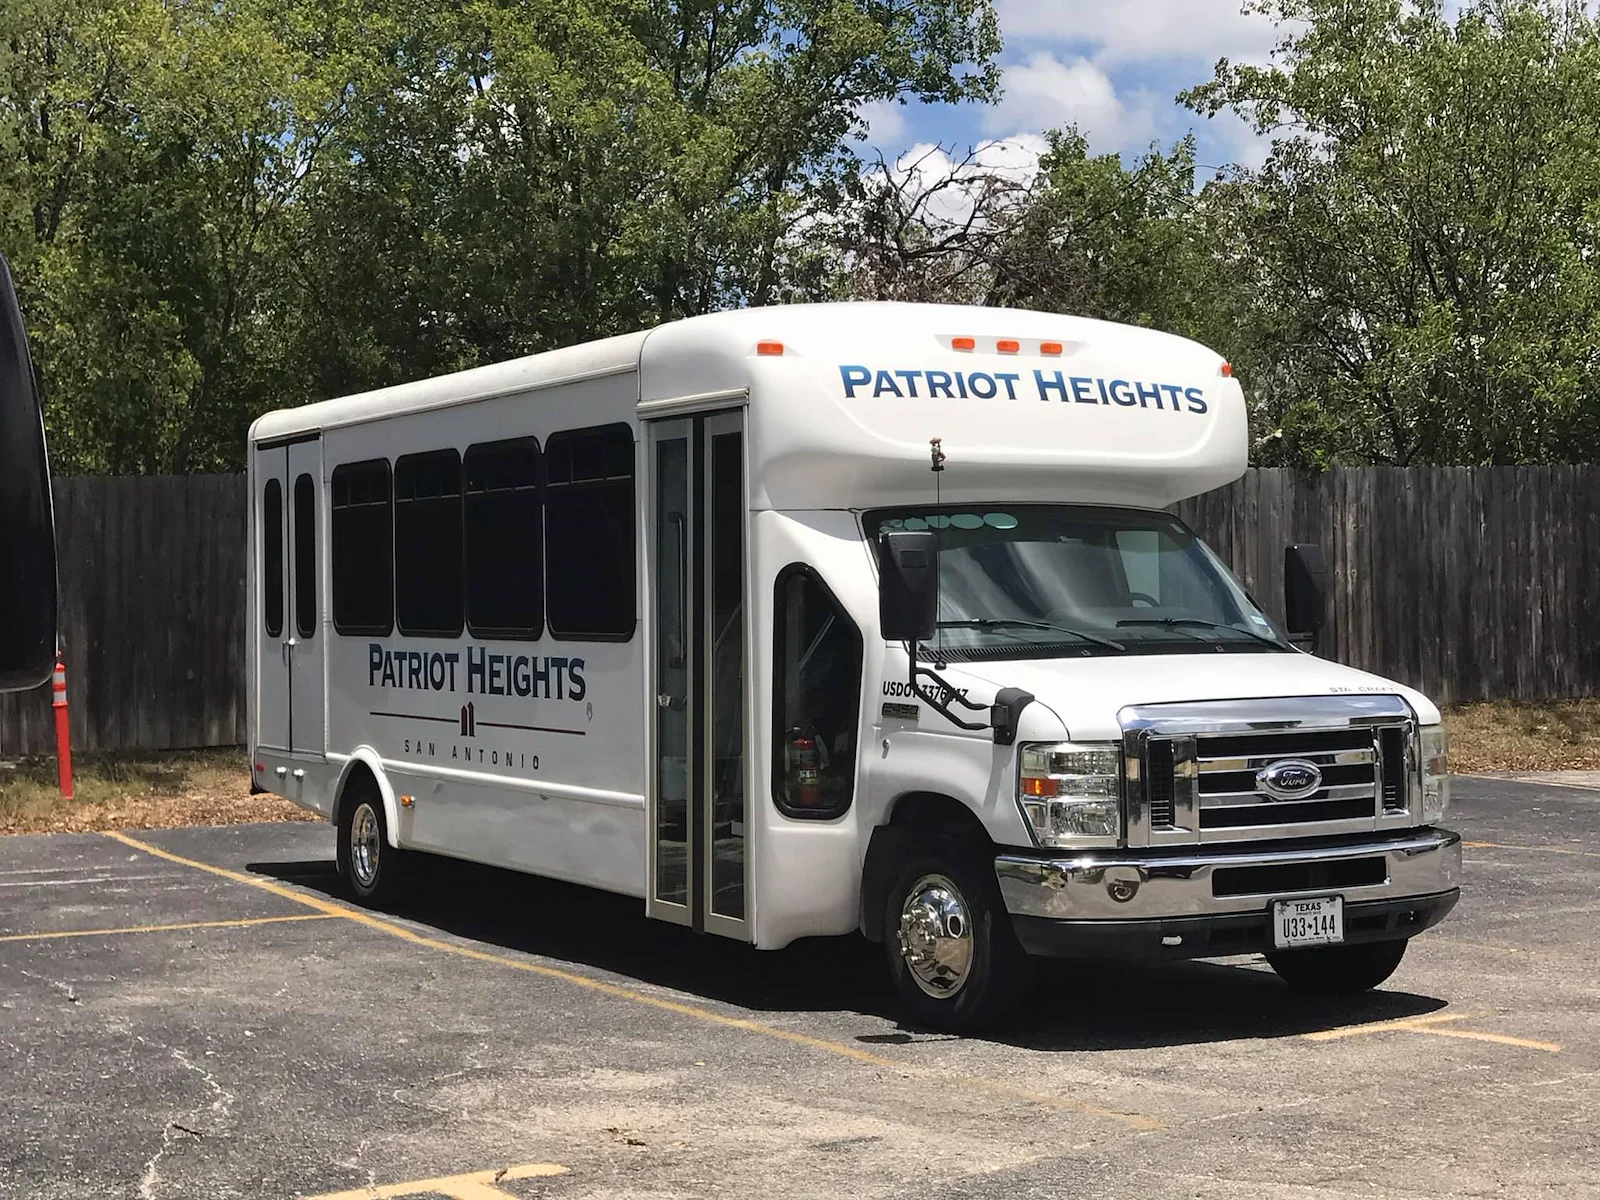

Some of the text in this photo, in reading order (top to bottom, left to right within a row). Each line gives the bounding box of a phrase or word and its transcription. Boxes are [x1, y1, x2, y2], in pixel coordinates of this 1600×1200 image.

[838, 365, 1207, 414] PATRIOT HEIGHTS
[369, 644, 586, 701] PATRIOT HEIGHTS
[404, 739, 539, 769] SAN ANTONIO
[1281, 771, 1308, 786] Ford
[1295, 902, 1322, 912] TEXAS
